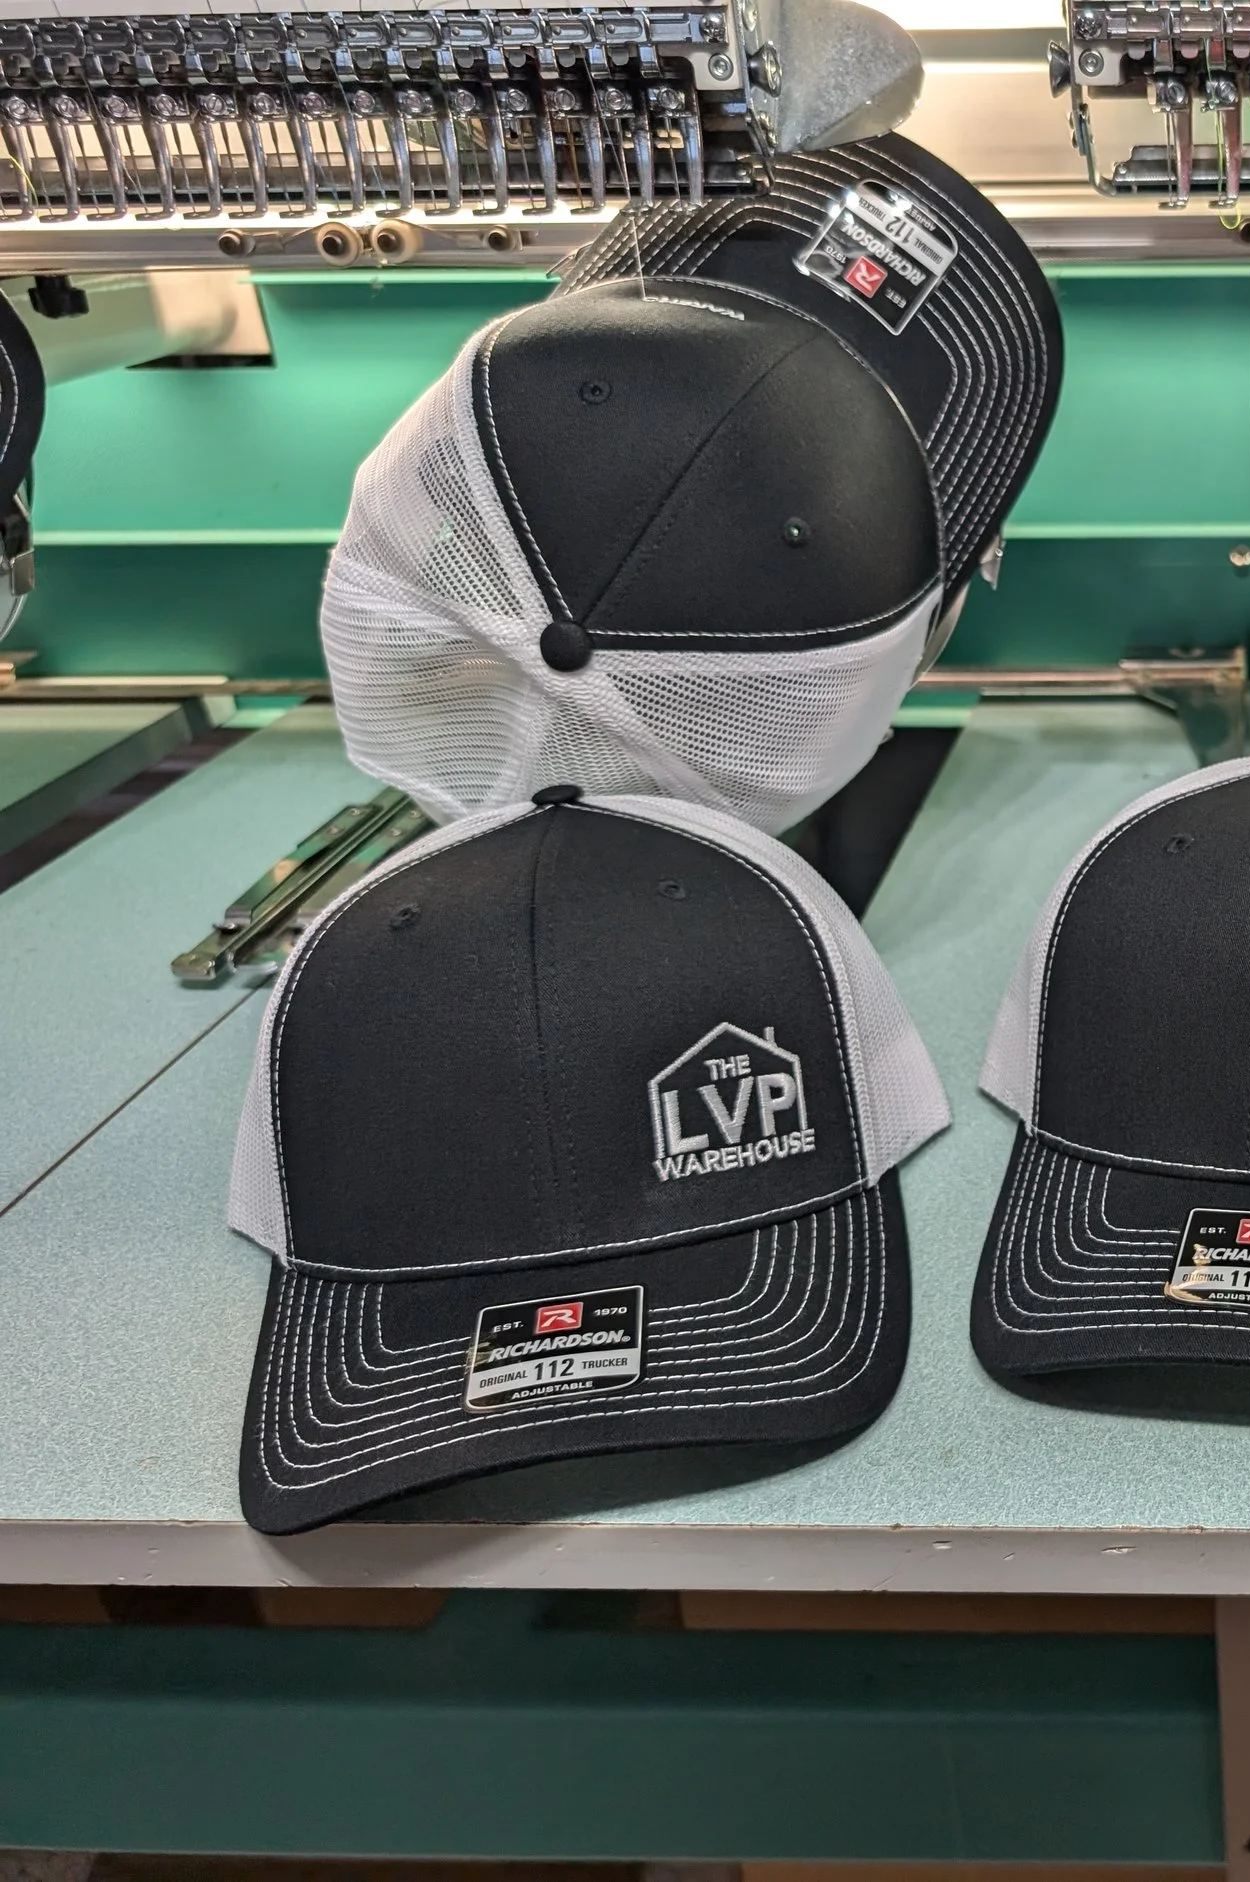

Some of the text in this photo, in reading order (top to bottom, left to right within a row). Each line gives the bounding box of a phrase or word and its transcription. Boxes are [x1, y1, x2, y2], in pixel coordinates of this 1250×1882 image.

[885, 216, 915, 243] 112
[825, 245, 847, 264] 1970
[914, 238, 943, 264] ORIGINAL
[703, 1054, 751, 1081] THE
[662, 1072, 796, 1155] LVP
[652, 1128, 815, 1182] WAREHOUSE
[492, 1306, 628, 1333] EST. 1970
[480, 1357, 628, 1389] ORIGINAL 112 TRUCKER
[511, 1380, 593, 1400] ADJUSTABLE
